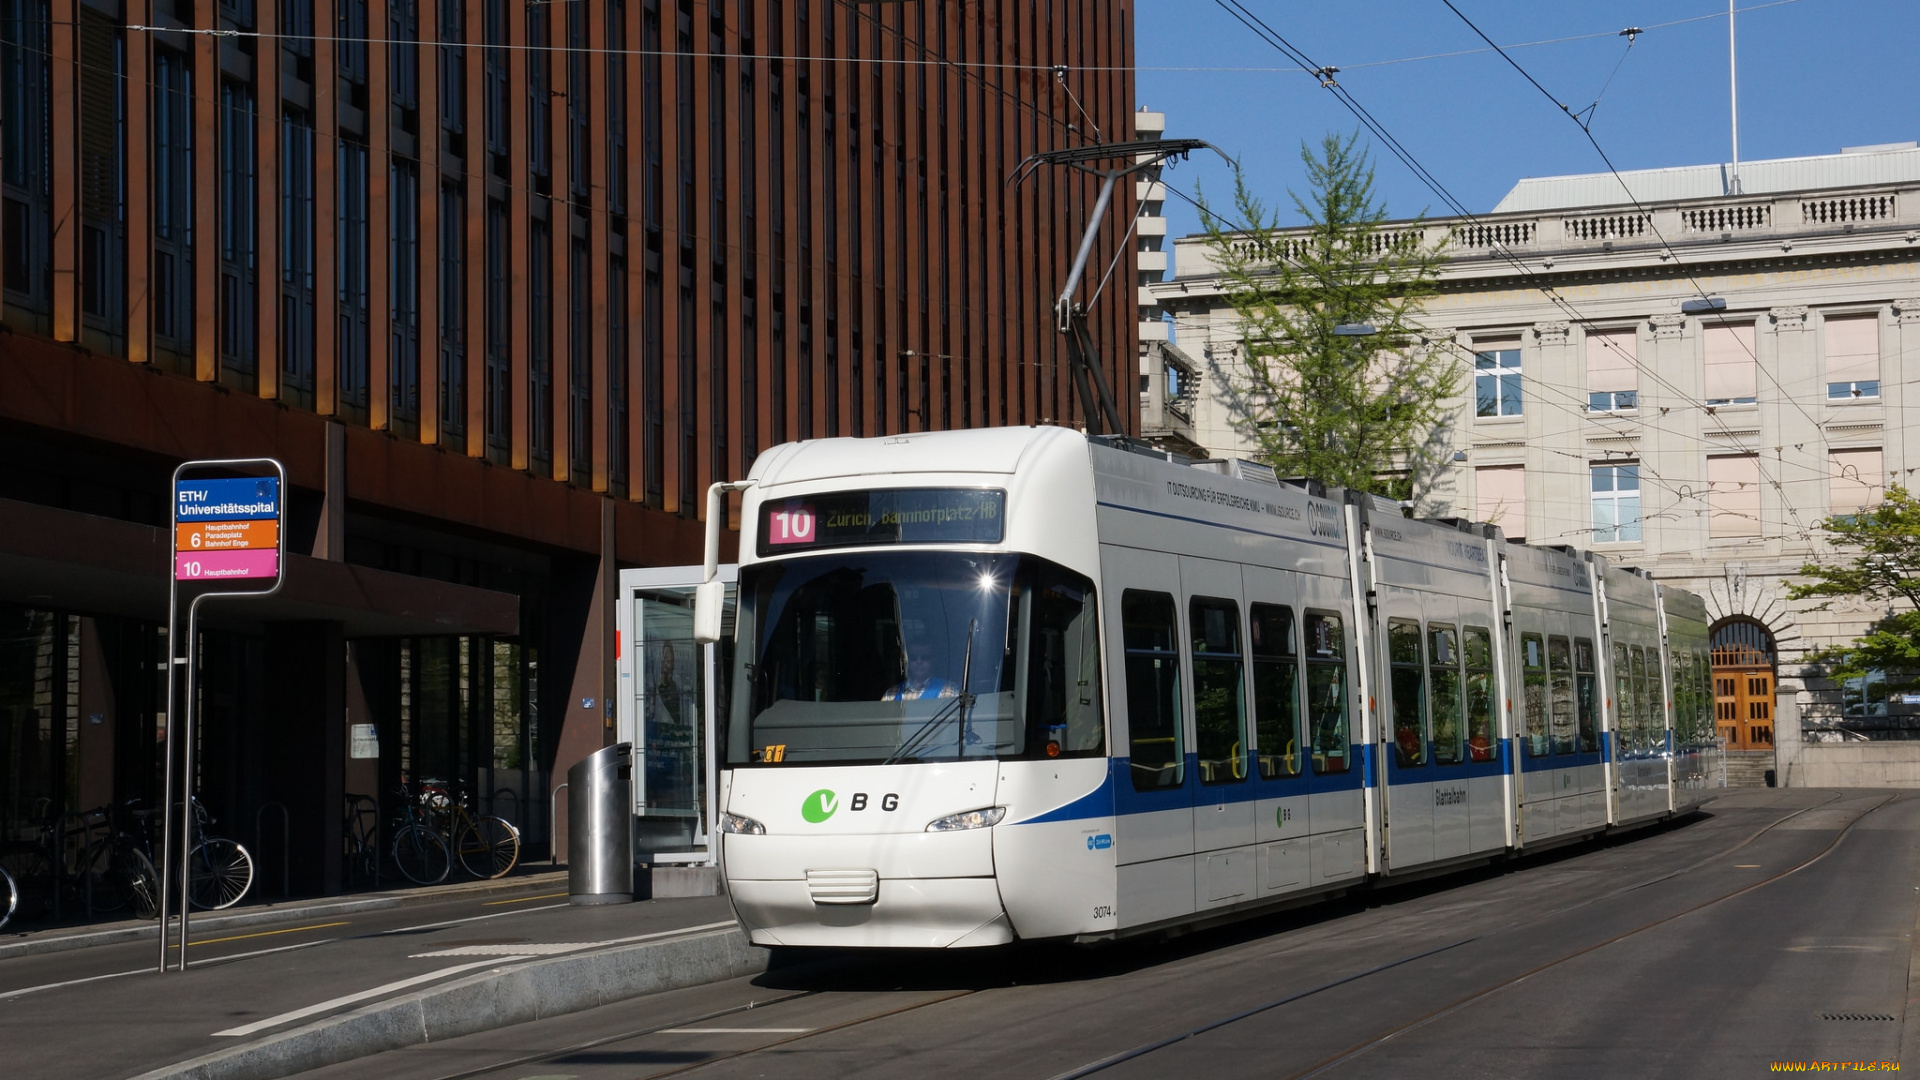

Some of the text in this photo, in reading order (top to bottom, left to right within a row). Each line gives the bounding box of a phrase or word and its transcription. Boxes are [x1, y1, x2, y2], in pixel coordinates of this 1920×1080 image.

[180, 490, 208, 502] ETH/
[180, 502, 274, 515] Universitätsspital
[205, 523, 250, 531] Hauptbahnhof
[776, 509, 811, 539] 10
[190, 533, 201, 548] 6
[205, 532, 243, 540] Paradeplatz
[205, 540, 249, 548] Bahnhof Enge
[184, 561, 201, 577] 10
[204, 568, 249, 577] Hauptbahnhof
[1094, 905, 1111, 918] 3074
